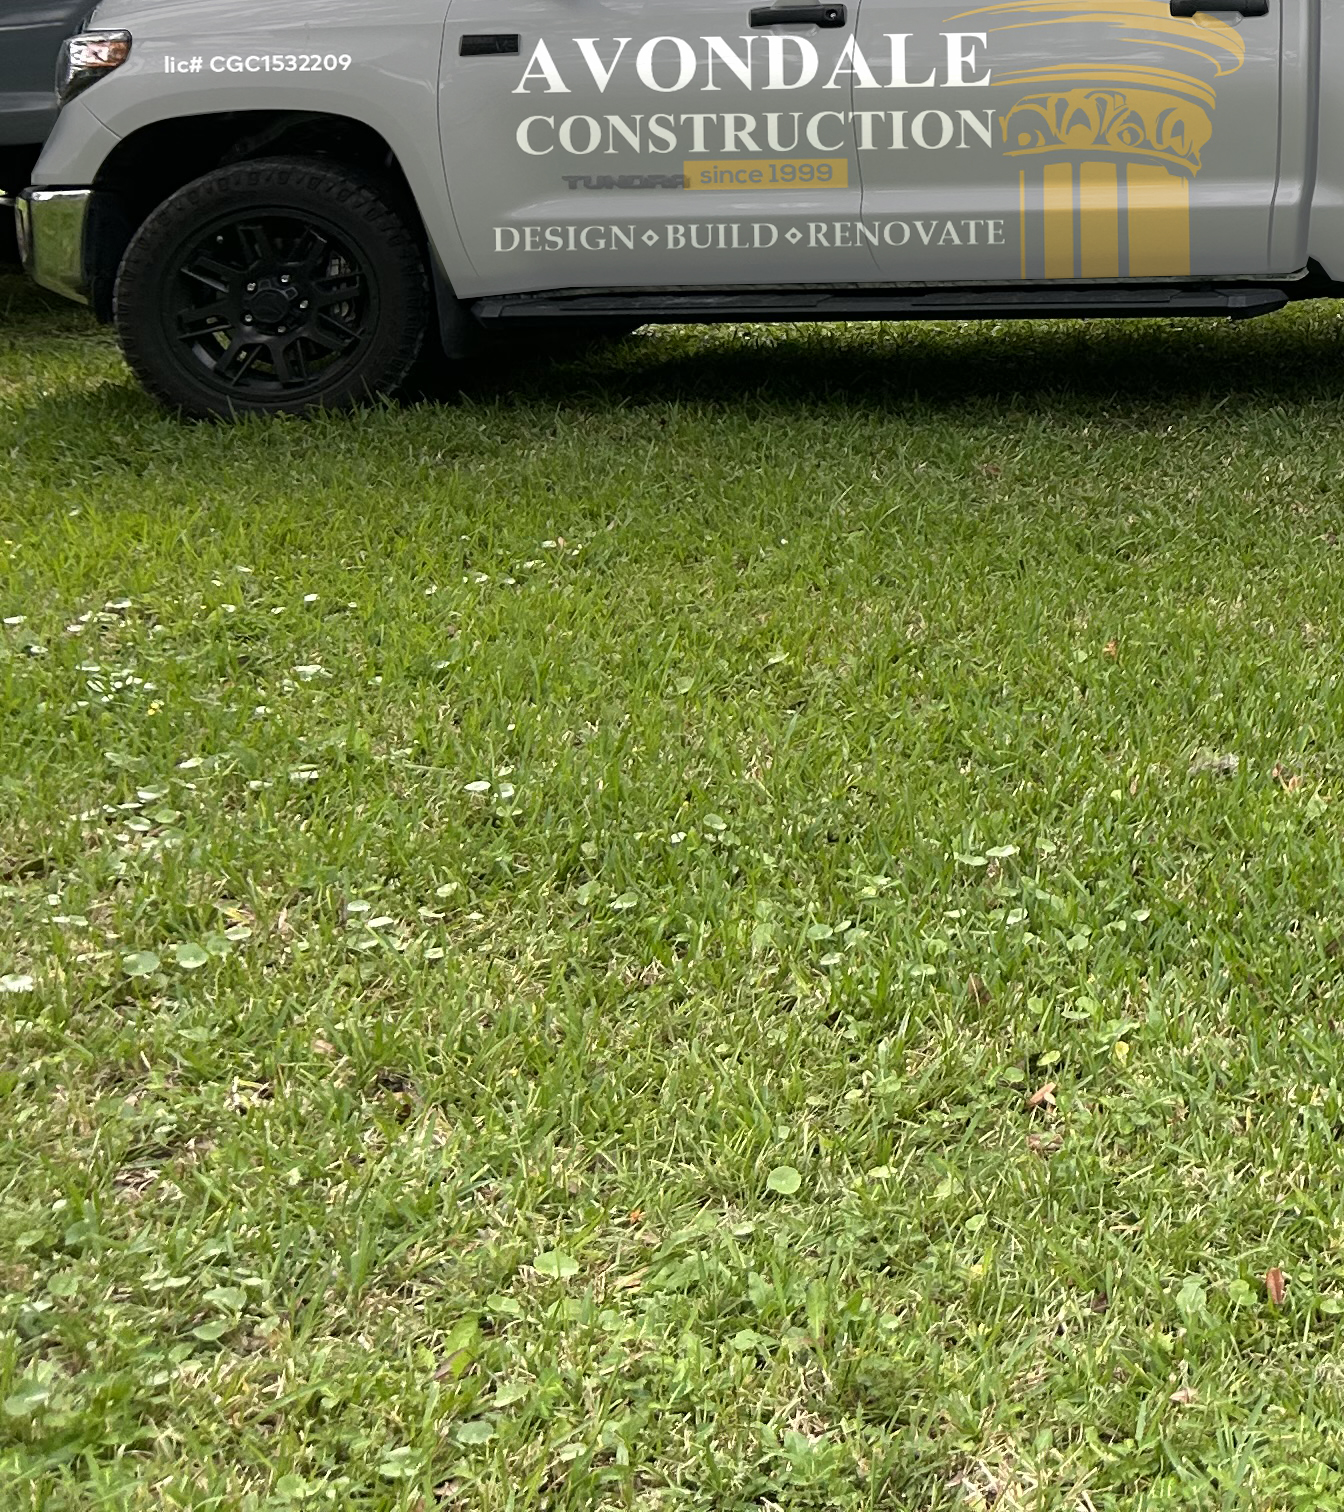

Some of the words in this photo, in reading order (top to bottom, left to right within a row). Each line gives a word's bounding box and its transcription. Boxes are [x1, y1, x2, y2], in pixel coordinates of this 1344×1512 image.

[164, 55, 203, 74] lic#
[209, 54, 352, 73] CGC1532209
[511, 32, 992, 94] AVONDALE
[515, 109, 997, 156] CONSTRUCTION
[562, 174, 691, 190] TUNDRA
[699, 165, 763, 185] since
[768, 163, 833, 183] 1999
[493, 224, 636, 252] DESIGN
[665, 222, 779, 250] BUILD
[806, 219, 1006, 248] RENOVATE
